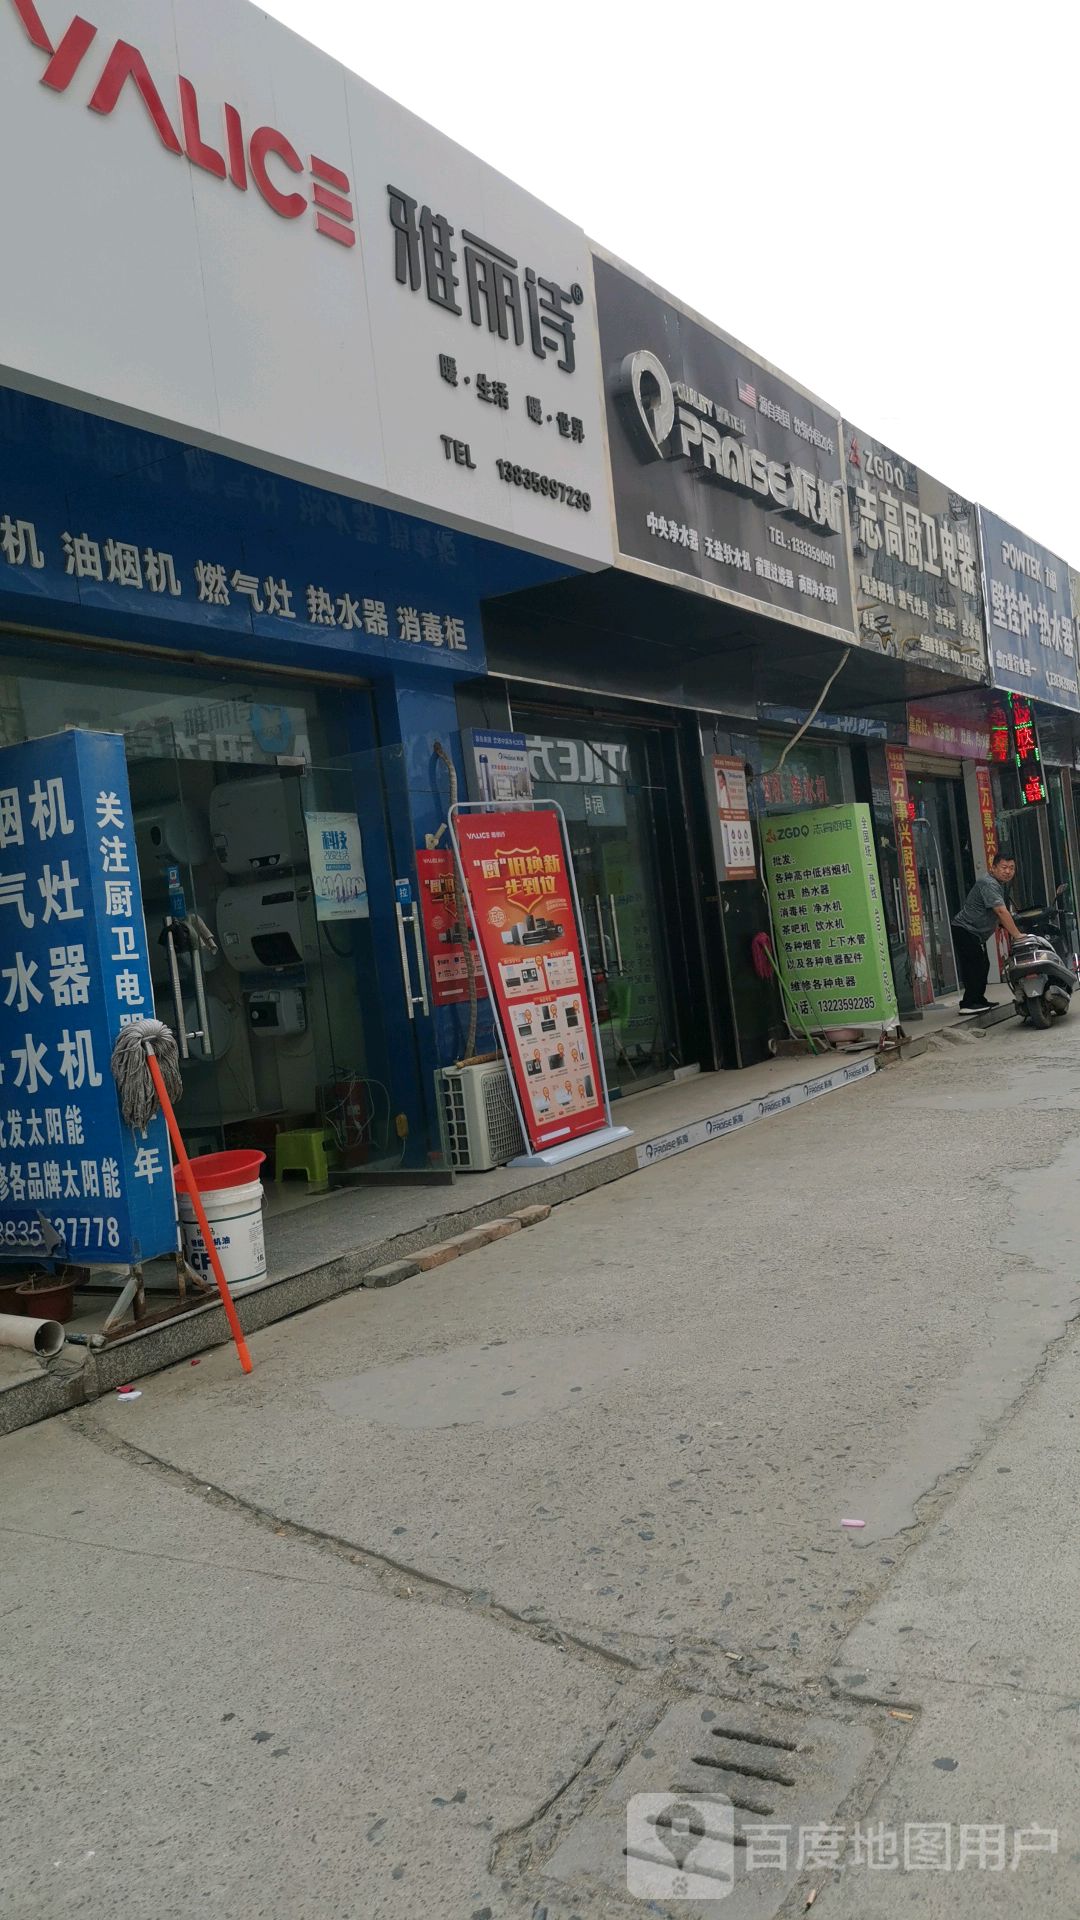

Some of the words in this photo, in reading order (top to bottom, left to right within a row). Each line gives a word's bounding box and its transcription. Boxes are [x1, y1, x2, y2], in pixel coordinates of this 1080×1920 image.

[386, 184, 577, 373] 雅丽诗
[440, 434, 476, 469] TEL
[495, 459, 591, 511] 13835997239
[647, 511, 698, 551] 中央净水器
[856, 480, 976, 597] 志高厨卫电器
[1001, 540, 1041, 583] POWTEK
[0, 516, 44, 569] 机
[61, 532, 181, 597] 油烟机
[194, 560, 297, 619] 燃气灶
[307, 585, 390, 638] 热水器
[396, 605, 468, 651] 消毒柜
[322, 831, 348, 849] 科技
[777, 825, 809, 840] ZGDQ
[892, 777, 922, 937] 万事兴厨房电器
[775, 864, 851, 884] 各种高中低档烟机
[487, 876, 558, 896] 一步到位
[777, 889, 795, 900] 灶具
[802, 884, 829, 897] 热水器
[780, 905, 807, 918] 消毒柜
[813, 901, 842, 914] 净水机
[782, 923, 810, 936] 茶吧机
[815, 919, 844, 932] 饮水机
[785, 939, 821, 952] 各种烟管
[828, 934, 865, 947] 上下水管
[787, 953, 862, 969] 以及各种电器配件
[2, 944, 91, 1013] 水器
[790, 976, 856, 991] 维修各种电器
[818, 997, 875, 1012] 13223592285
